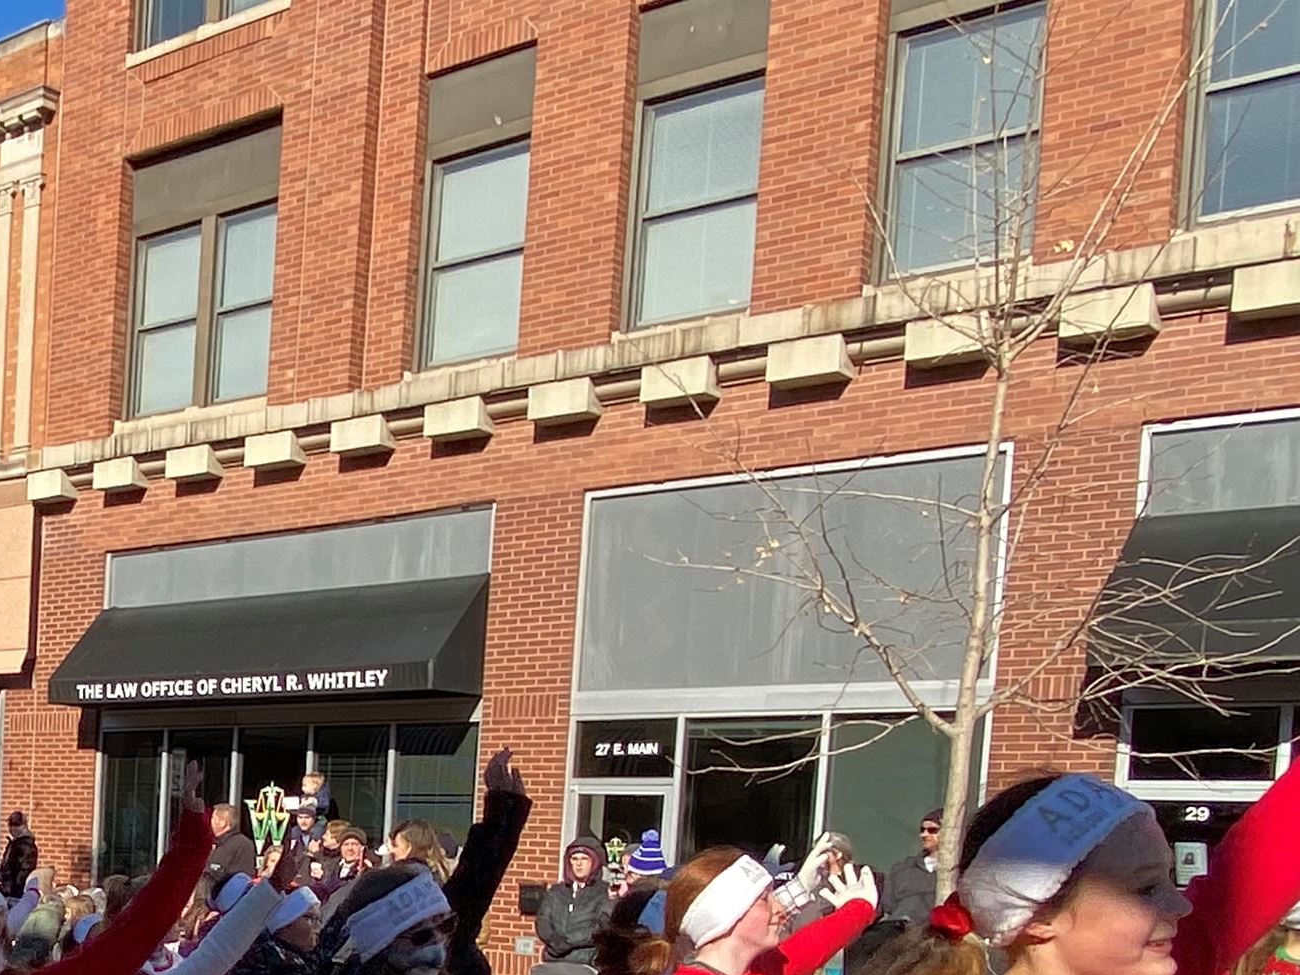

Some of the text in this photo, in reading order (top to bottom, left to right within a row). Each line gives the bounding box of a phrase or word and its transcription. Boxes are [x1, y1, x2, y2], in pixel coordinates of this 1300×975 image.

[76, 669, 388, 699] THE LAW OFFICE OF CHERYL R. WHITLEY
[595, 742, 659, 756] 27 E. MAIN
[1185, 806, 1210, 822] 29
